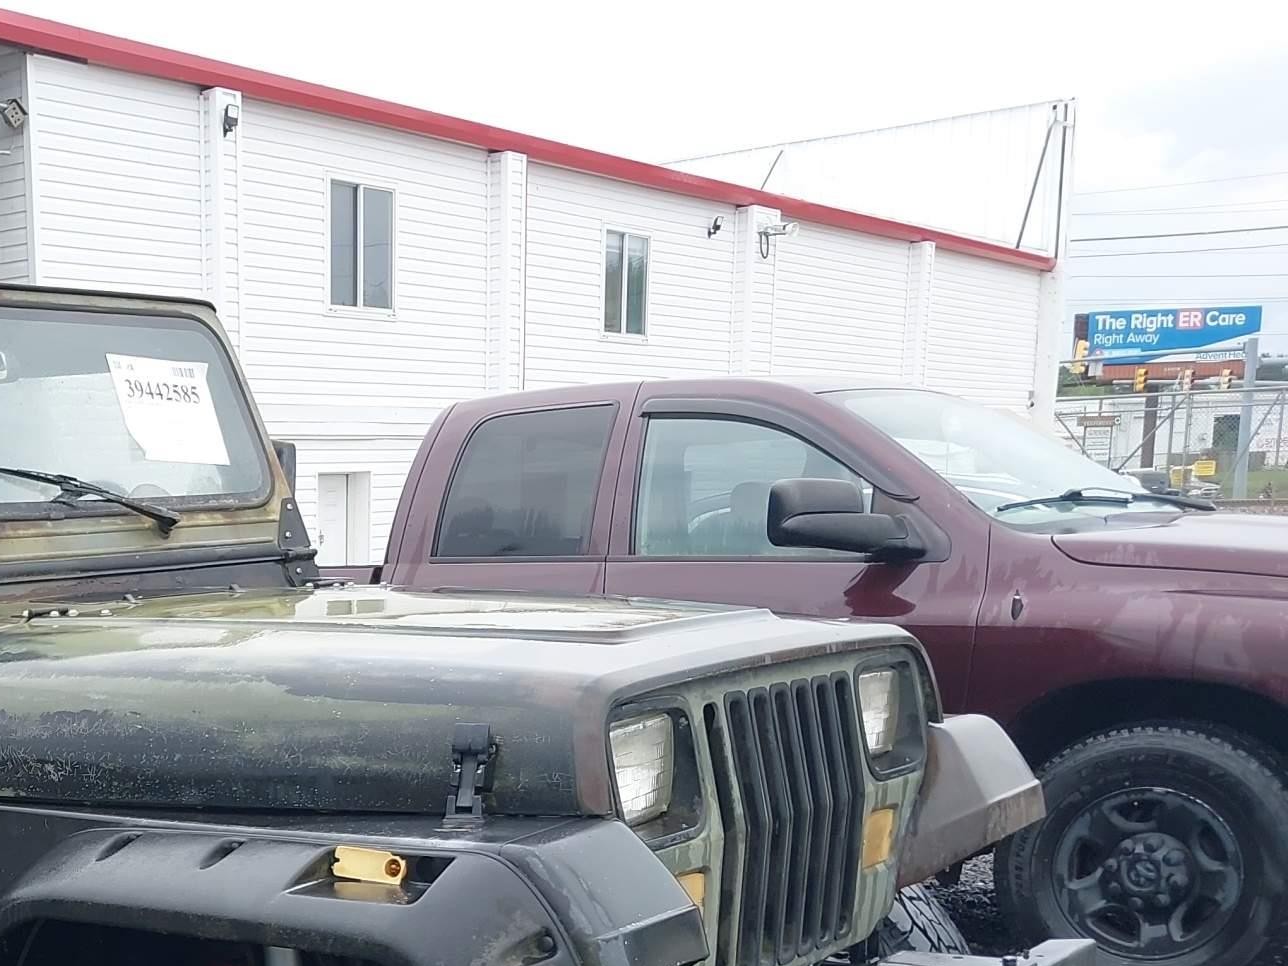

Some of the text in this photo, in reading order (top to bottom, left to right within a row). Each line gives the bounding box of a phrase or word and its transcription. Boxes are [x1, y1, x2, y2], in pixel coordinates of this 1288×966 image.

[1095, 311, 1246, 331] The Right ER Care
[1094, 333, 1160, 346] Right Away
[124, 379, 201, 404] 39442585
